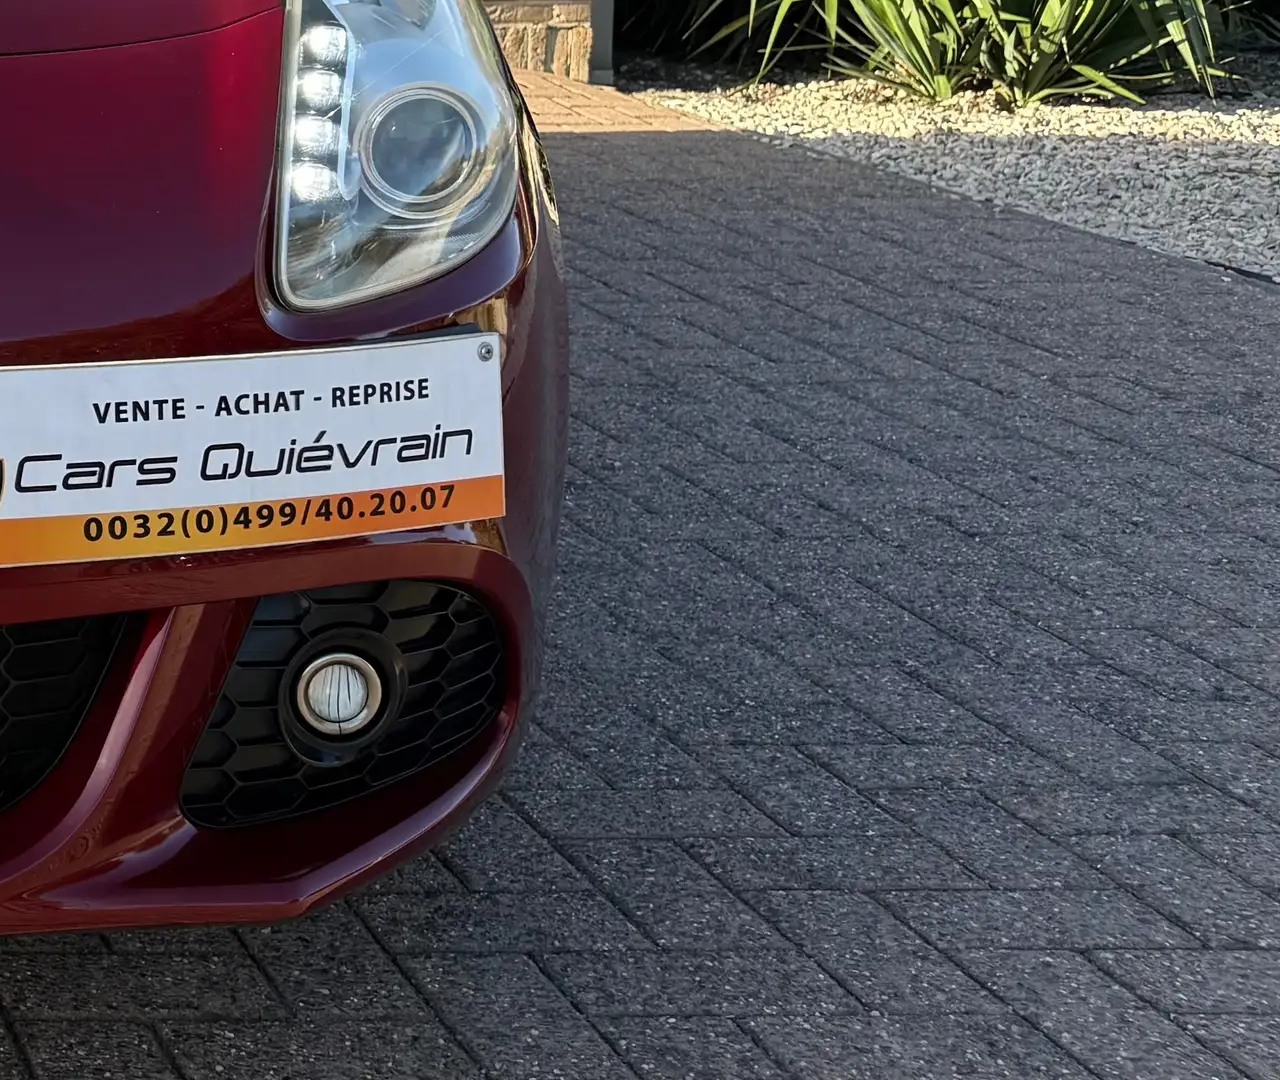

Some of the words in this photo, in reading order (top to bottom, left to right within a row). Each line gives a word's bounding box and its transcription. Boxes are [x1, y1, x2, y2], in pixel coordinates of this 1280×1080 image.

[92, 397, 186, 424] VENTE
[214, 389, 305, 417] ACHAT
[331, 378, 429, 408] REPRISE
[14, 453, 178, 494] Cars
[200, 423, 473, 482] Quiévrain
[82, 483, 456, 542] 0032(0)499/40.20.07
